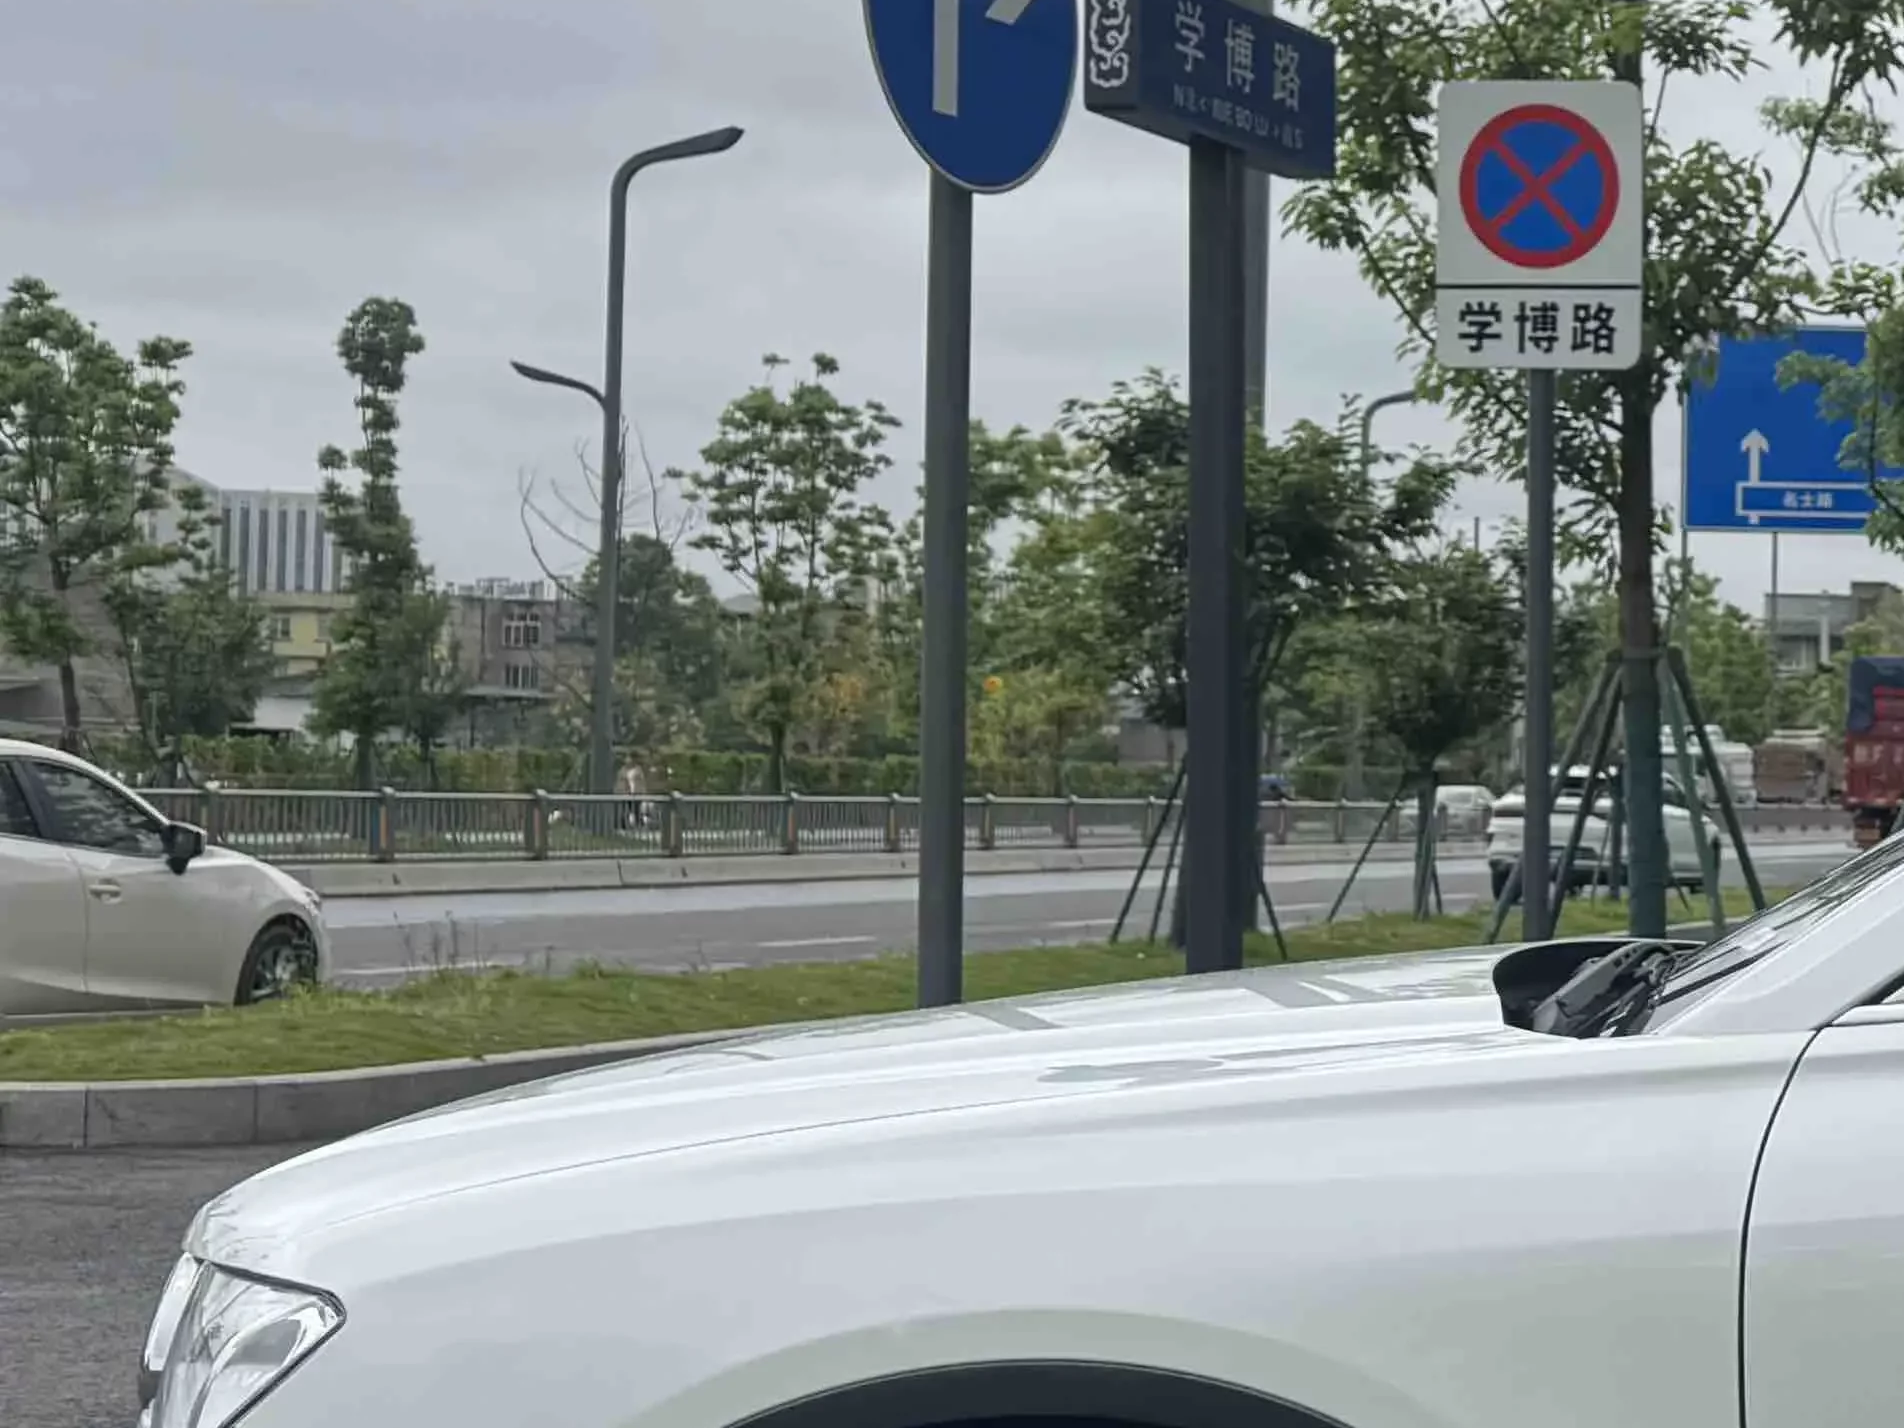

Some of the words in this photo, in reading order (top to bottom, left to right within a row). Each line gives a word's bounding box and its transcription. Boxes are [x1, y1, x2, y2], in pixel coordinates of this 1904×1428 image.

[1175, 0, 1300, 112] 学博路
[1458, 301, 1617, 355] 学博路
